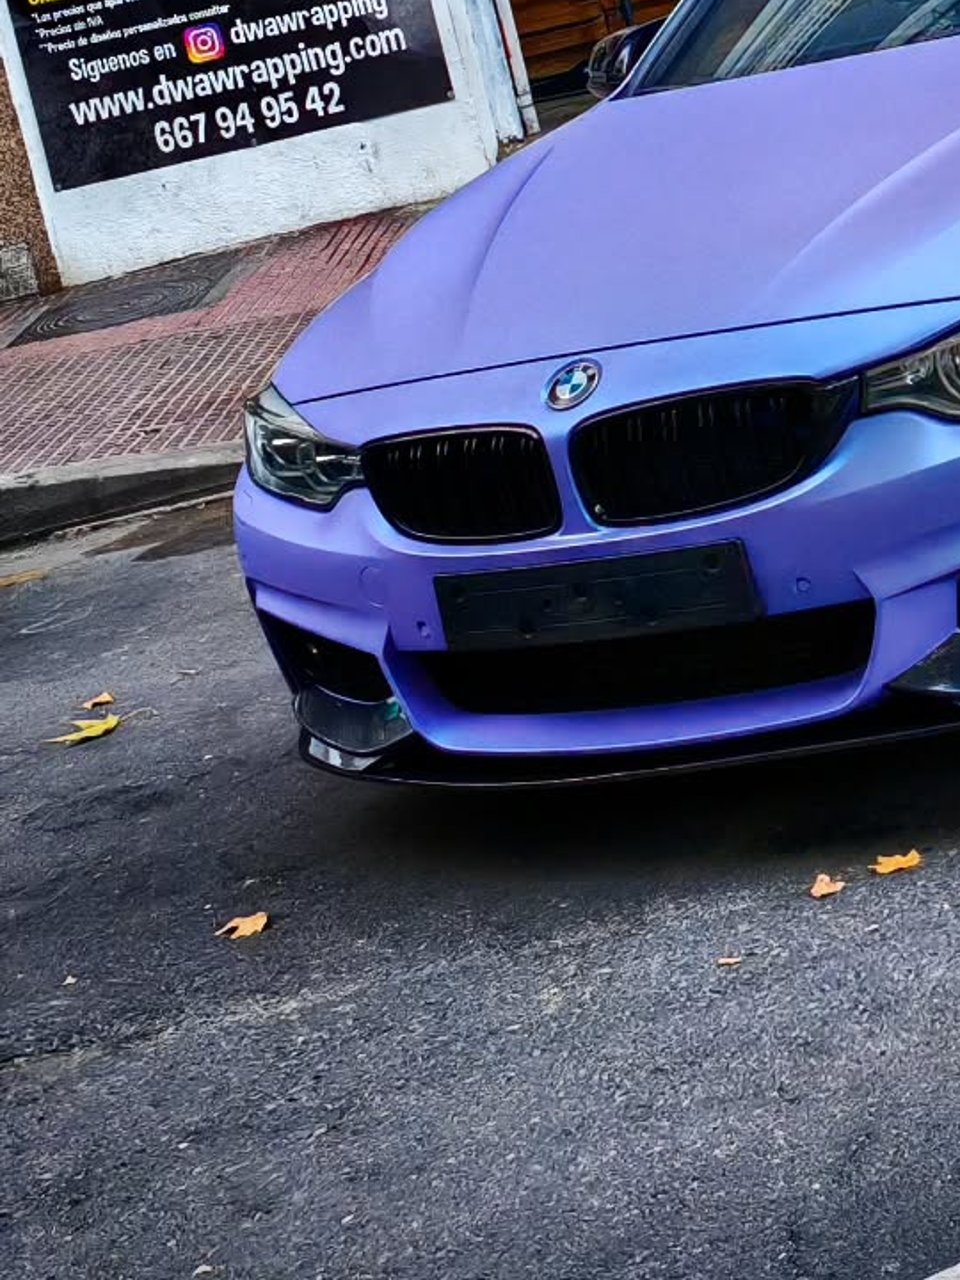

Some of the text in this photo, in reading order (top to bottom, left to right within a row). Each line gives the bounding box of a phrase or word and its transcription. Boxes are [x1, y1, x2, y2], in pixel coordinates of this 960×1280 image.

[69, 26, 406, 126] www.dwawrapping.com
[153, 42, 177, 61] en
[154, 81, 346, 154] 667 94 95 42
